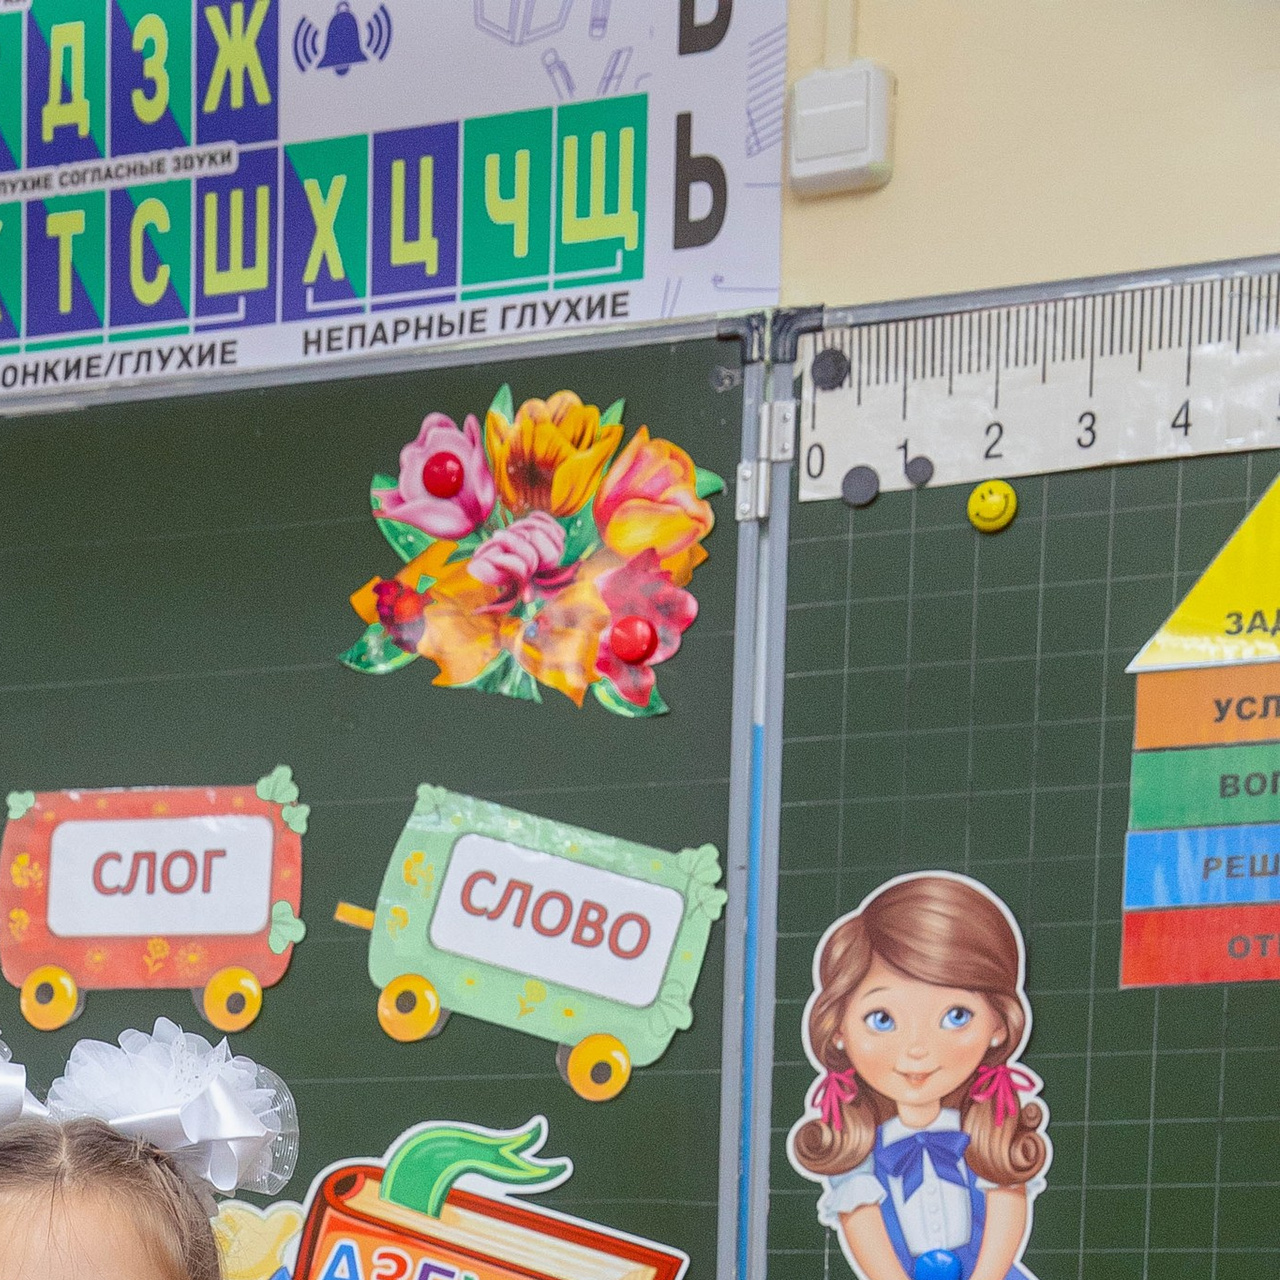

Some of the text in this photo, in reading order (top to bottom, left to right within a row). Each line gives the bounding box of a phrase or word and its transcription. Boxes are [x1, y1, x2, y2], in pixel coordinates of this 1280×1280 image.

[59, 156, 167, 188] СОГЛАСНЫЕ
[172, 149, 233, 173] ЗВУКИ
[673, 110, 729, 250] Ь
[302, 291, 630, 356] НЕПАРНЫЕ ГЛУХИЕ
[807, 399, 1193, 479] 0 1 2 3 4
[92, 850, 227, 897] СЛОГ
[458, 870, 651, 961] СЛОВО
[1227, 933, 1280, 960] ОТ
